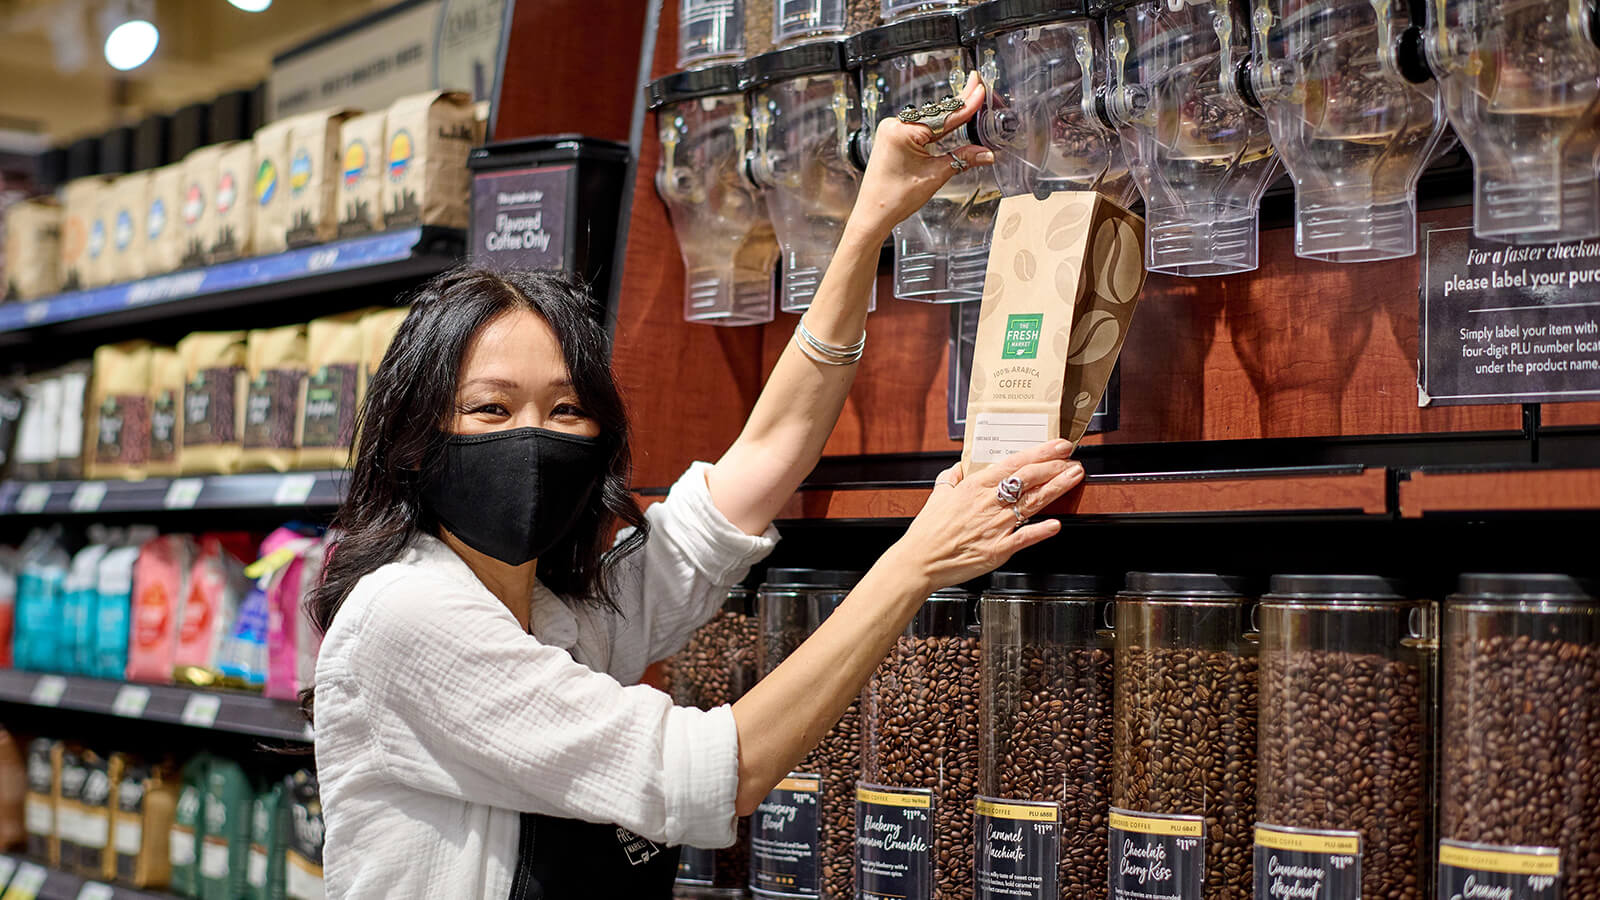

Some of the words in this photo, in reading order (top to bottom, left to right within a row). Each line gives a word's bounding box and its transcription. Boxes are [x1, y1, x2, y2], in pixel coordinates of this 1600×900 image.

[496, 210, 542, 233] Flavored
[486, 232, 522, 251] Coffee
[522, 229, 551, 252] Only
[1466, 248, 1492, 266] For
[1492, 251, 1500, 264] a
[1502, 246, 1545, 266] faster
[1444, 274, 1488, 296] please
[1492, 270, 1526, 288] label
[1531, 273, 1566, 290] your
[1006, 330, 1039, 340] FRESH
[1460, 326, 1493, 342] Simply
[1496, 324, 1520, 337] label
[1522, 327, 1546, 340] your
[1549, 324, 1572, 336] item
[1574, 320, 1598, 334] with
[1462, 344, 1508, 359] four-digit
[1510, 342, 1530, 355] PLU
[1534, 340, 1574, 354] number
[1011, 366, 1040, 378] ARABICA
[1476, 362, 1504, 374] under
[1507, 360, 1524, 373] the
[1526, 358, 1567, 375] product
[1570, 360, 1600, 370] name.
[998, 380, 1032, 388] COFFEE
[864, 815, 902, 840] Blueberry
[986, 824, 1024, 842] Caramel
[884, 834, 928, 852] Crumble
[984, 842, 1025, 862] Macchiato
[1123, 838, 1166, 860] Chocolate
[1278, 838, 1302, 846] COFFEE
[1120, 857, 1148, 884] Cherry
[1148, 861, 1172, 881] Kiss
[1268, 856, 1326, 880] Cinnamon
[1270, 875, 1322, 900] Hazelnut
[1463, 874, 1512, 900] Creamy
